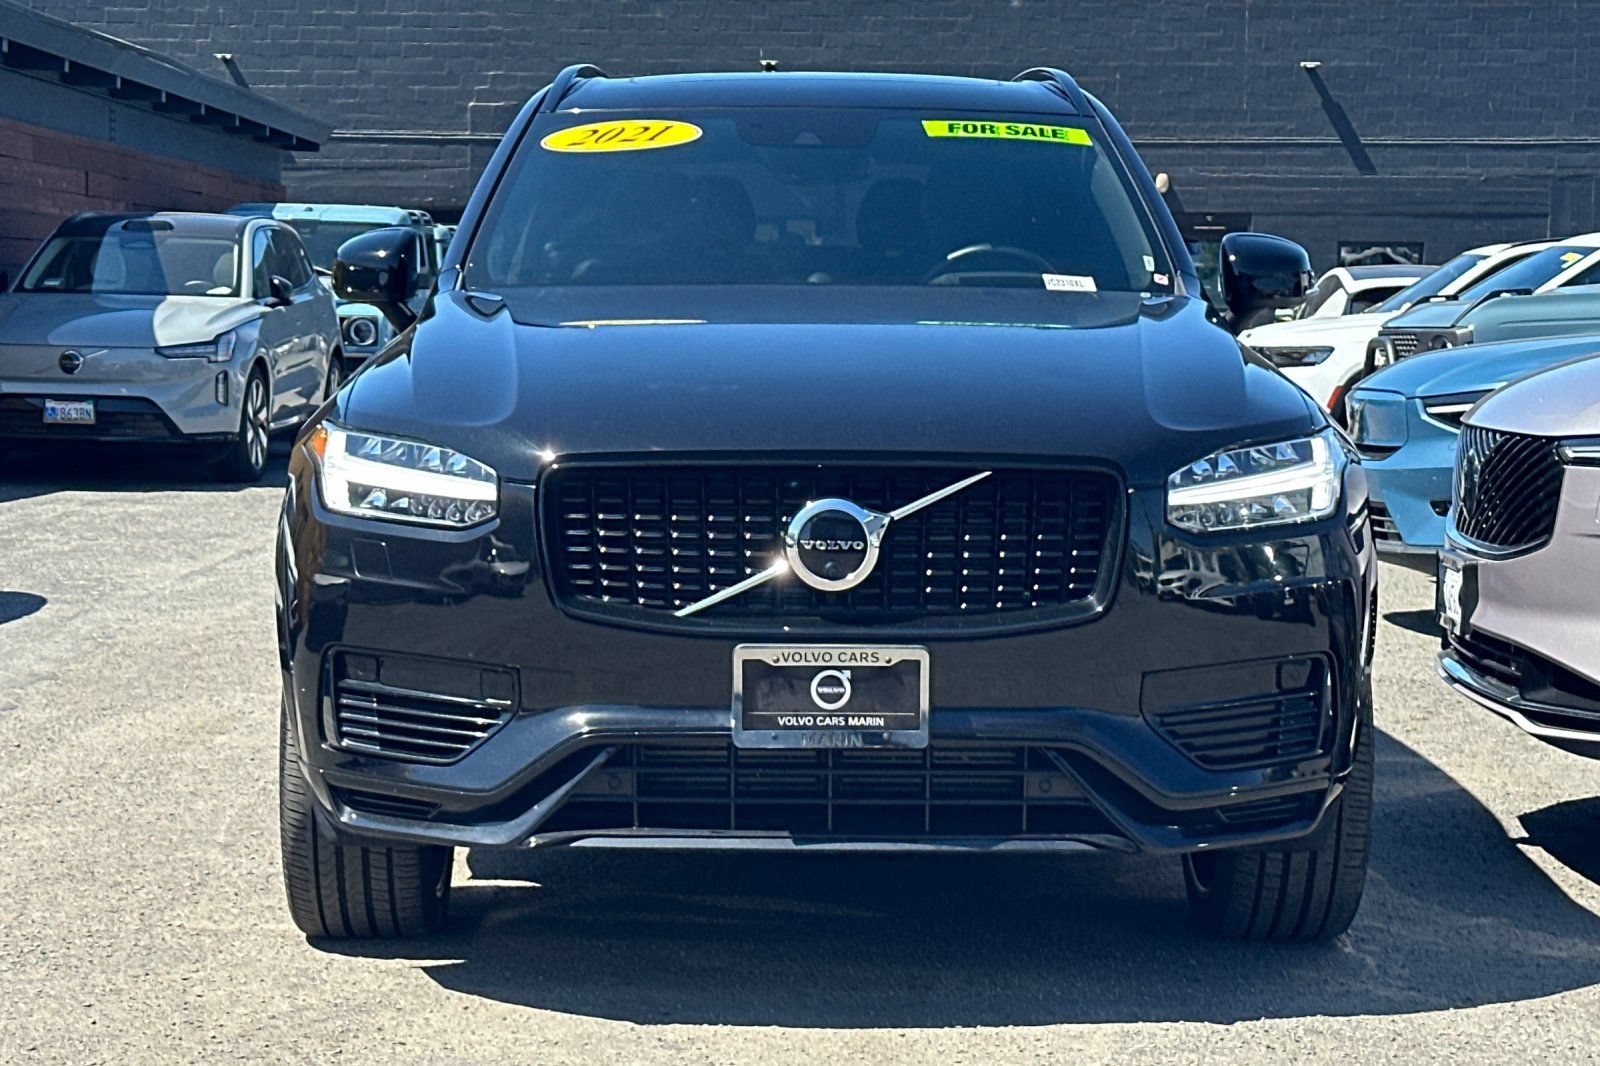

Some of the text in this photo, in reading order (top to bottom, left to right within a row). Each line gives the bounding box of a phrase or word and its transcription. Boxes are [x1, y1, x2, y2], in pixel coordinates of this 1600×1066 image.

[566, 125, 674, 147] 2021
[947, 122, 1068, 140] FOR SALE
[800, 539, 865, 551] VOLVO
[781, 651, 880, 663] VOLVO CARS
[817, 686, 845, 694] VOLVO
[777, 716, 885, 727] VOLVO CARS MARIN
[801, 731, 864, 748] MARIN
